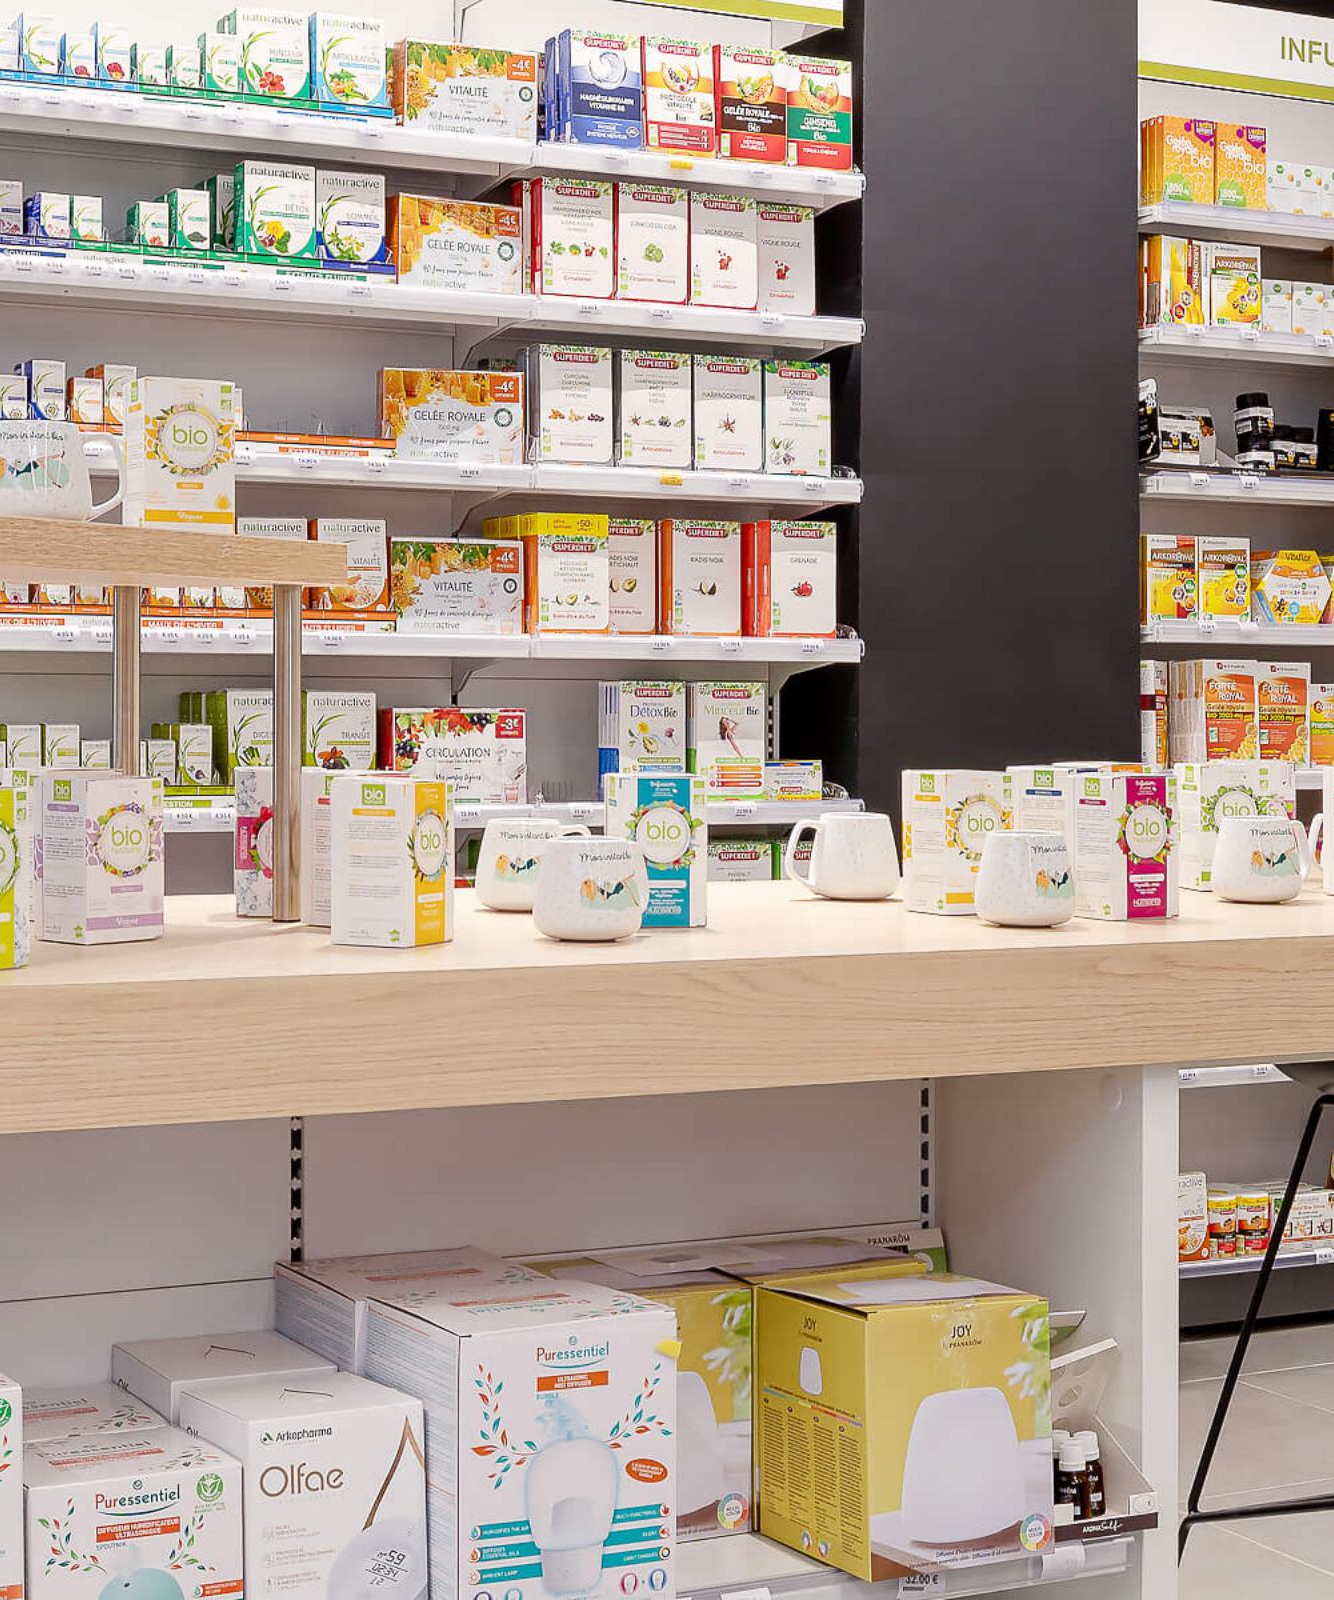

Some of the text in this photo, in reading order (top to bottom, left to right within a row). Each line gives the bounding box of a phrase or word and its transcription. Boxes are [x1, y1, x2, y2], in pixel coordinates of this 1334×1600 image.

[449, 84, 490, 98] VITALITÉ
[1191, 155, 1211, 169] bio
[1244, 160, 1265, 174] bio
[250, 166, 310, 181] naturactive
[322, 175, 380, 190] naturactive
[557, 187, 598, 198] SUPERDIET
[633, 192, 673, 204] SUPERDIET
[704, 201, 741, 211] SUPERDIET
[762, 211, 800, 222] SUPERDIET
[427, 235, 491, 256] GELÉE ROYALE
[554, 352, 594, 363] SUPERDIET
[636, 358, 676, 369] SUPERDIET
[707, 362, 747, 374] SUPERDIET
[414, 408, 486, 422] GELÉE ROYALE
[172, 424, 208, 447] bio
[243, 522, 302, 532] naturactive
[323, 523, 380, 533] naturactive
[687, 527, 725, 537] SUPERDIET
[784, 529, 821, 538] SUPERDIET
[553, 542, 593, 552] SUPERDIET
[434, 580, 474, 593] VITALITÉ
[635, 689, 670, 698] SUPERDIET
[713, 690, 749, 698] SUPERDIET
[1219, 692, 1245, 701] ROYAL
[1271, 694, 1297, 703] ROYAL
[233, 696, 273, 707] naturac
[313, 697, 370, 707] naturactive
[426, 747, 490, 758] CIRCULATION
[55, 781, 70, 799] bio
[363, 787, 384, 801] bio
[1222, 801, 1250, 818] bio
[967, 814, 995, 833] bio
[1133, 817, 1160, 836] bio
[111, 825, 143, 848] bio
[646, 820, 681, 842] bio
[420, 829, 441, 850] bio
[719, 852, 756, 861] SUPERDIET
[803, 1316, 817, 1332] JOY
[951, 1325, 972, 1340] JOY
[536, 1339, 609, 1362] Puressentiel
[275, 1427, 332, 1442] Arkopharma
[259, 1462, 344, 1497] Olfae
[95, 1484, 180, 1510] Puressentiel
[905, 1574, 939, 1585] 32.00 €
